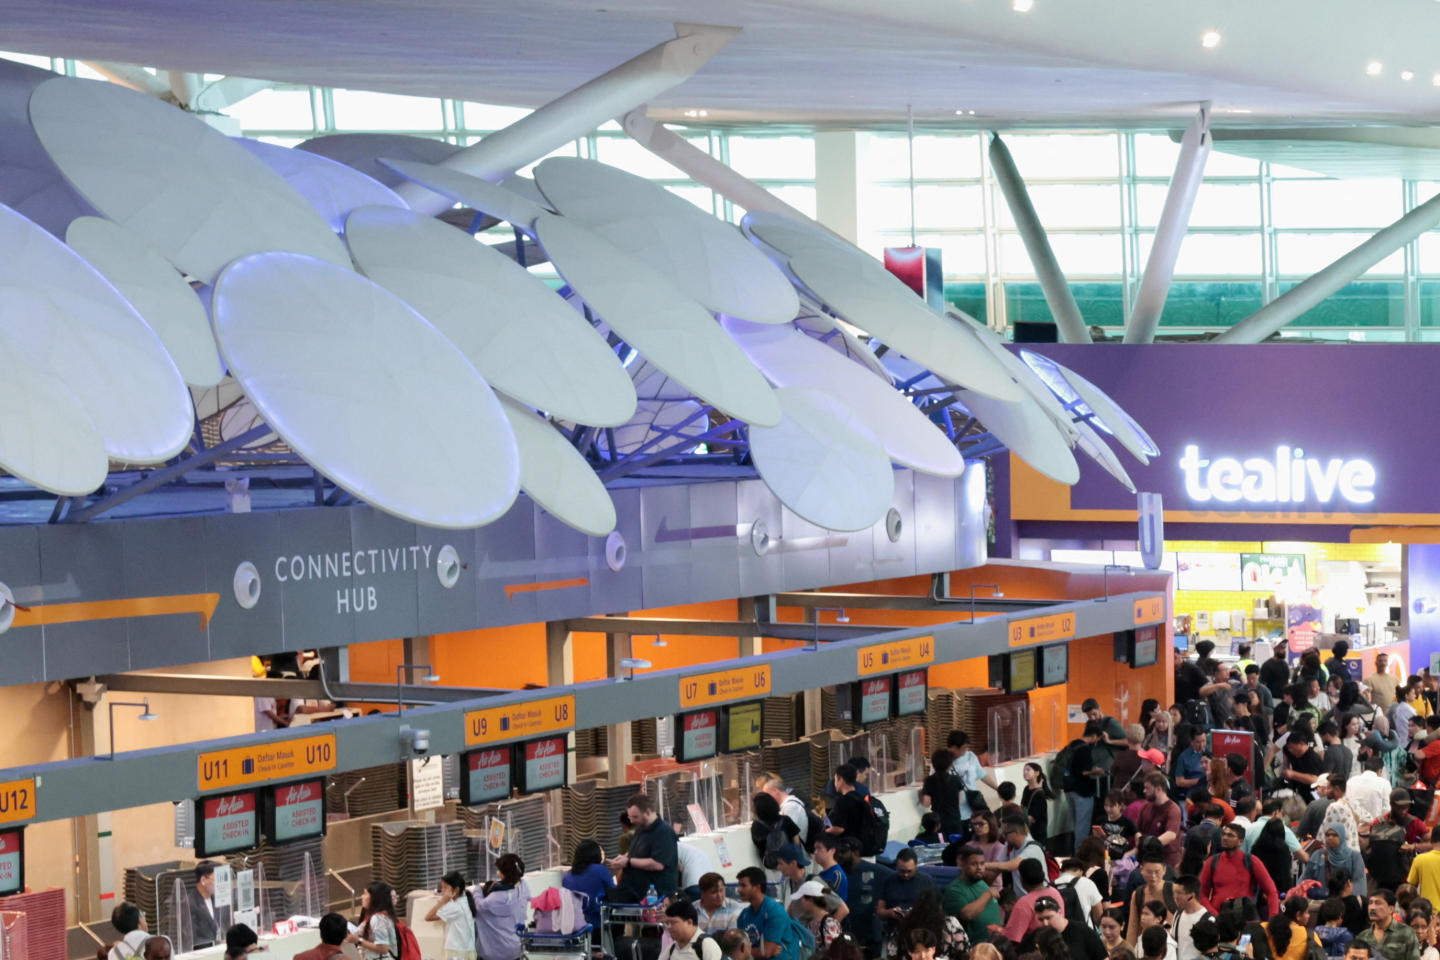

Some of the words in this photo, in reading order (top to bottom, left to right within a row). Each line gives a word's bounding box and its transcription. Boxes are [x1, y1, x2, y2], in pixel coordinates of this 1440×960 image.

[1179, 444, 1376, 503] tealive
[275, 545, 432, 582] CONNECTIVITY
[337, 586, 377, 614] HUB
[1013, 627, 1022, 641] U3
[919, 642, 930, 658] U4
[863, 653, 873, 668] U5
[754, 672, 766, 688] U6
[685, 683, 698, 699] U7
[554, 704, 569, 721] U8
[473, 718, 487, 736] U9
[257, 753, 275, 763] Daftar
[276, 750, 294, 760] Masuk
[306, 743, 331, 764] U10
[203, 759, 228, 781] U11
[0, 788, 29, 814] U12
[291, 808, 316, 818] ASSISTED
[222, 819, 249, 831] ASSISTED
[292, 817, 317, 827] CHECK-IN
[222, 829, 249, 841] CHECK-IN
